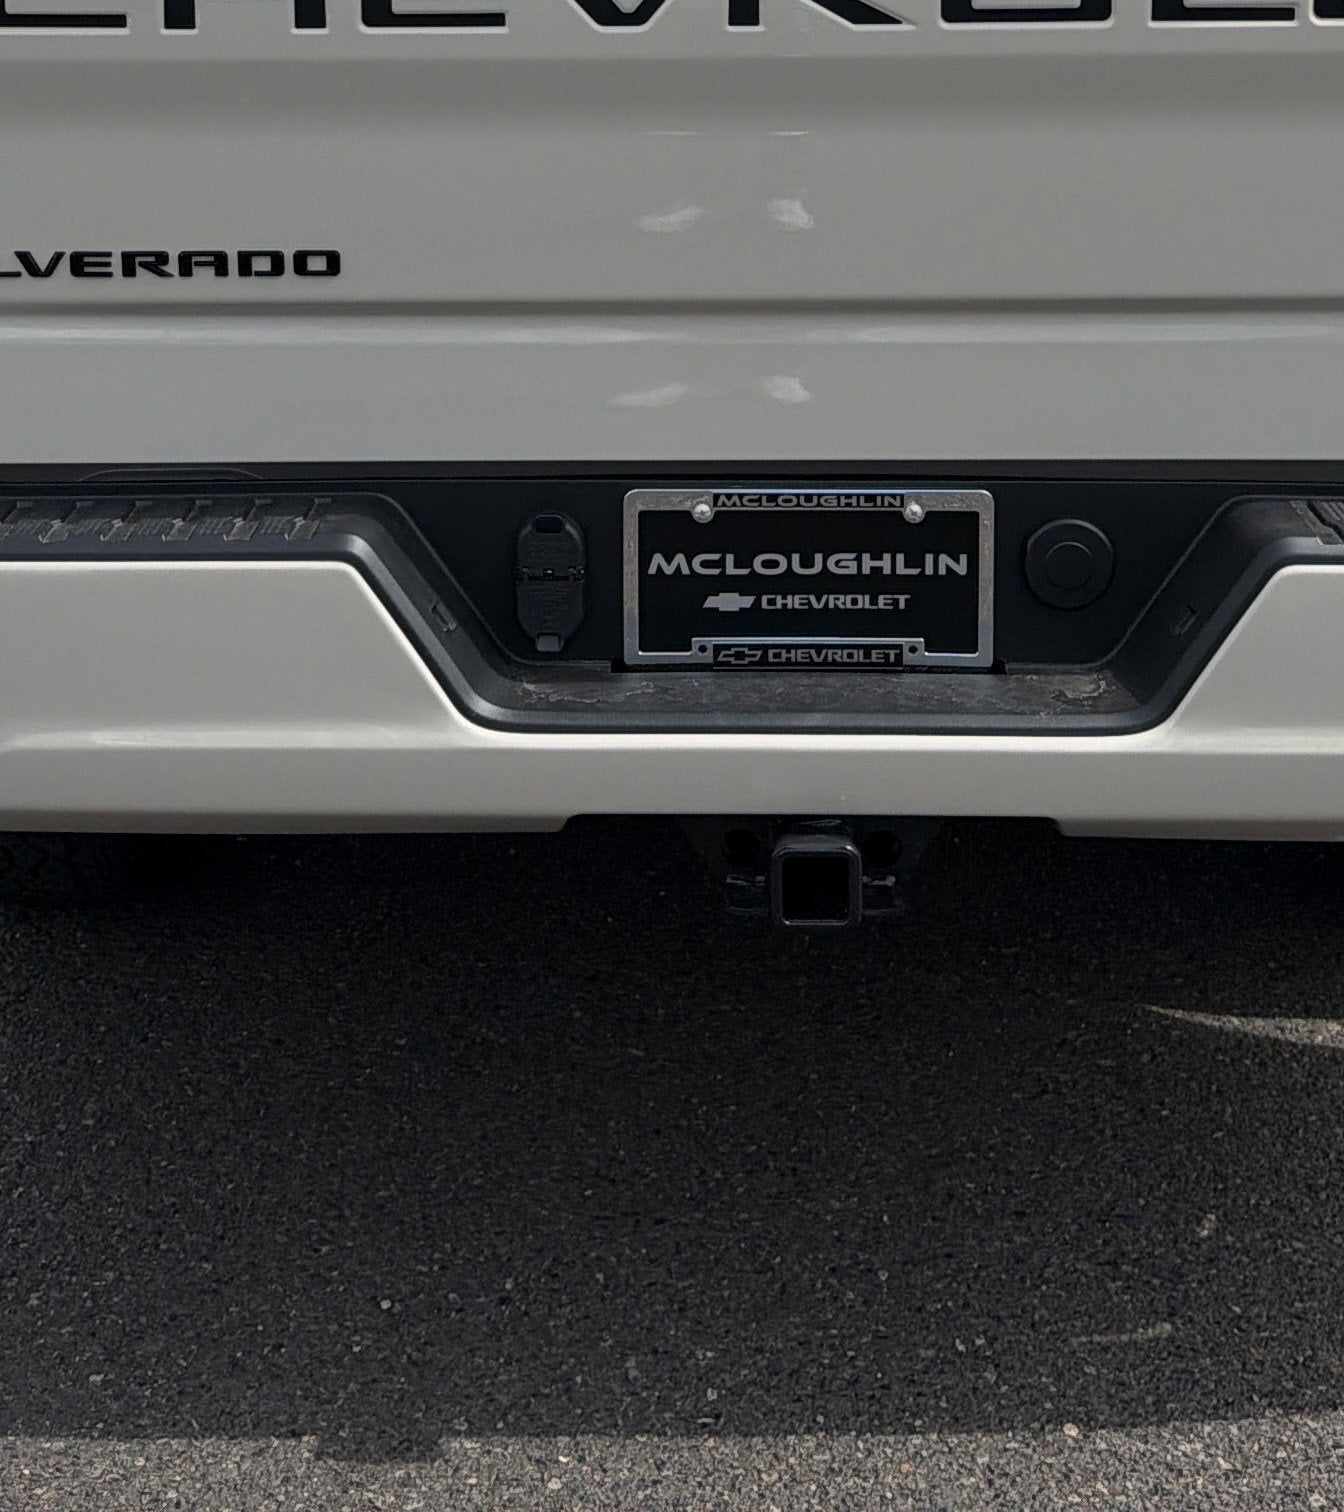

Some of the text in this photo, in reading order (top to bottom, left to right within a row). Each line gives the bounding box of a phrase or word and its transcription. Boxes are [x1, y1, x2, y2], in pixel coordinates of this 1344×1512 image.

[716, 494, 902, 508] MCLOUGHLIN
[647, 553, 969, 576] MCLOUGHLIN
[761, 594, 912, 610] CHEVROLET
[767, 648, 901, 663] CHEVROLET
